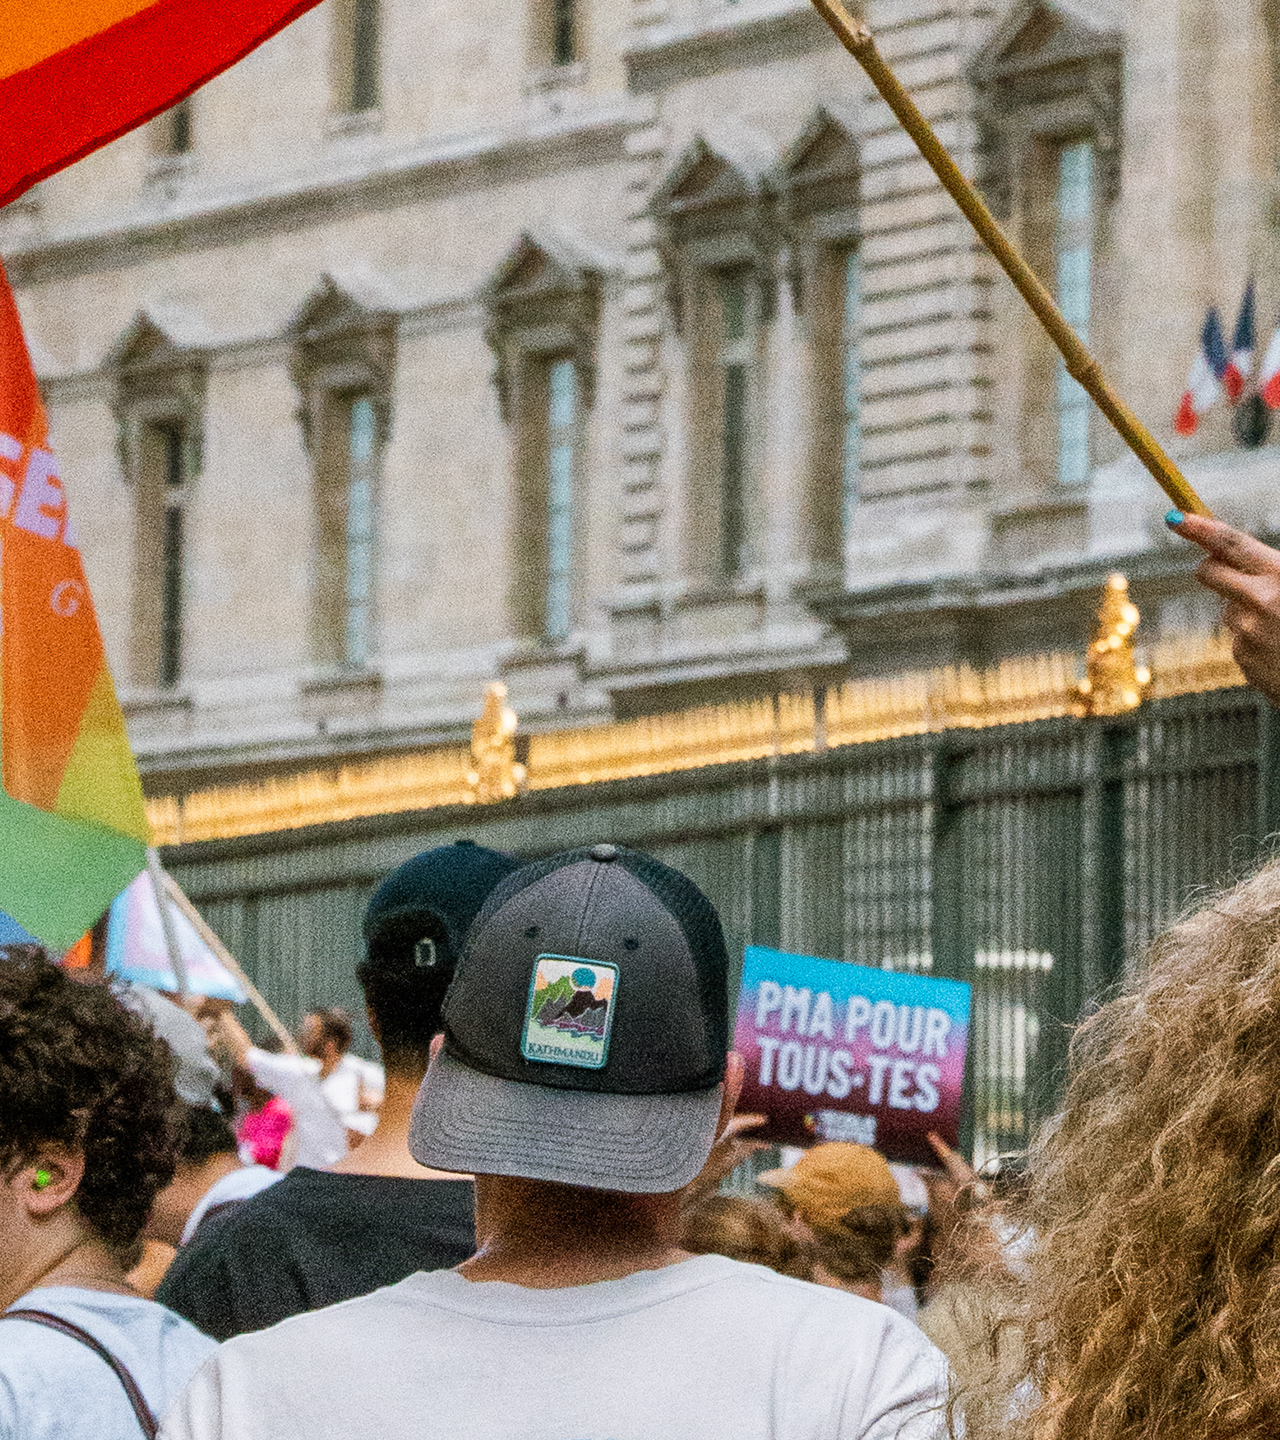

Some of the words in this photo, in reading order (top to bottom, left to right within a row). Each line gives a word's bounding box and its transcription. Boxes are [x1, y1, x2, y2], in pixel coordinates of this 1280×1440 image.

[755, 980, 835, 1040] PMA
[844, 995, 952, 1058] POUR
[527, 1042, 600, 1062] KATHMANDU
